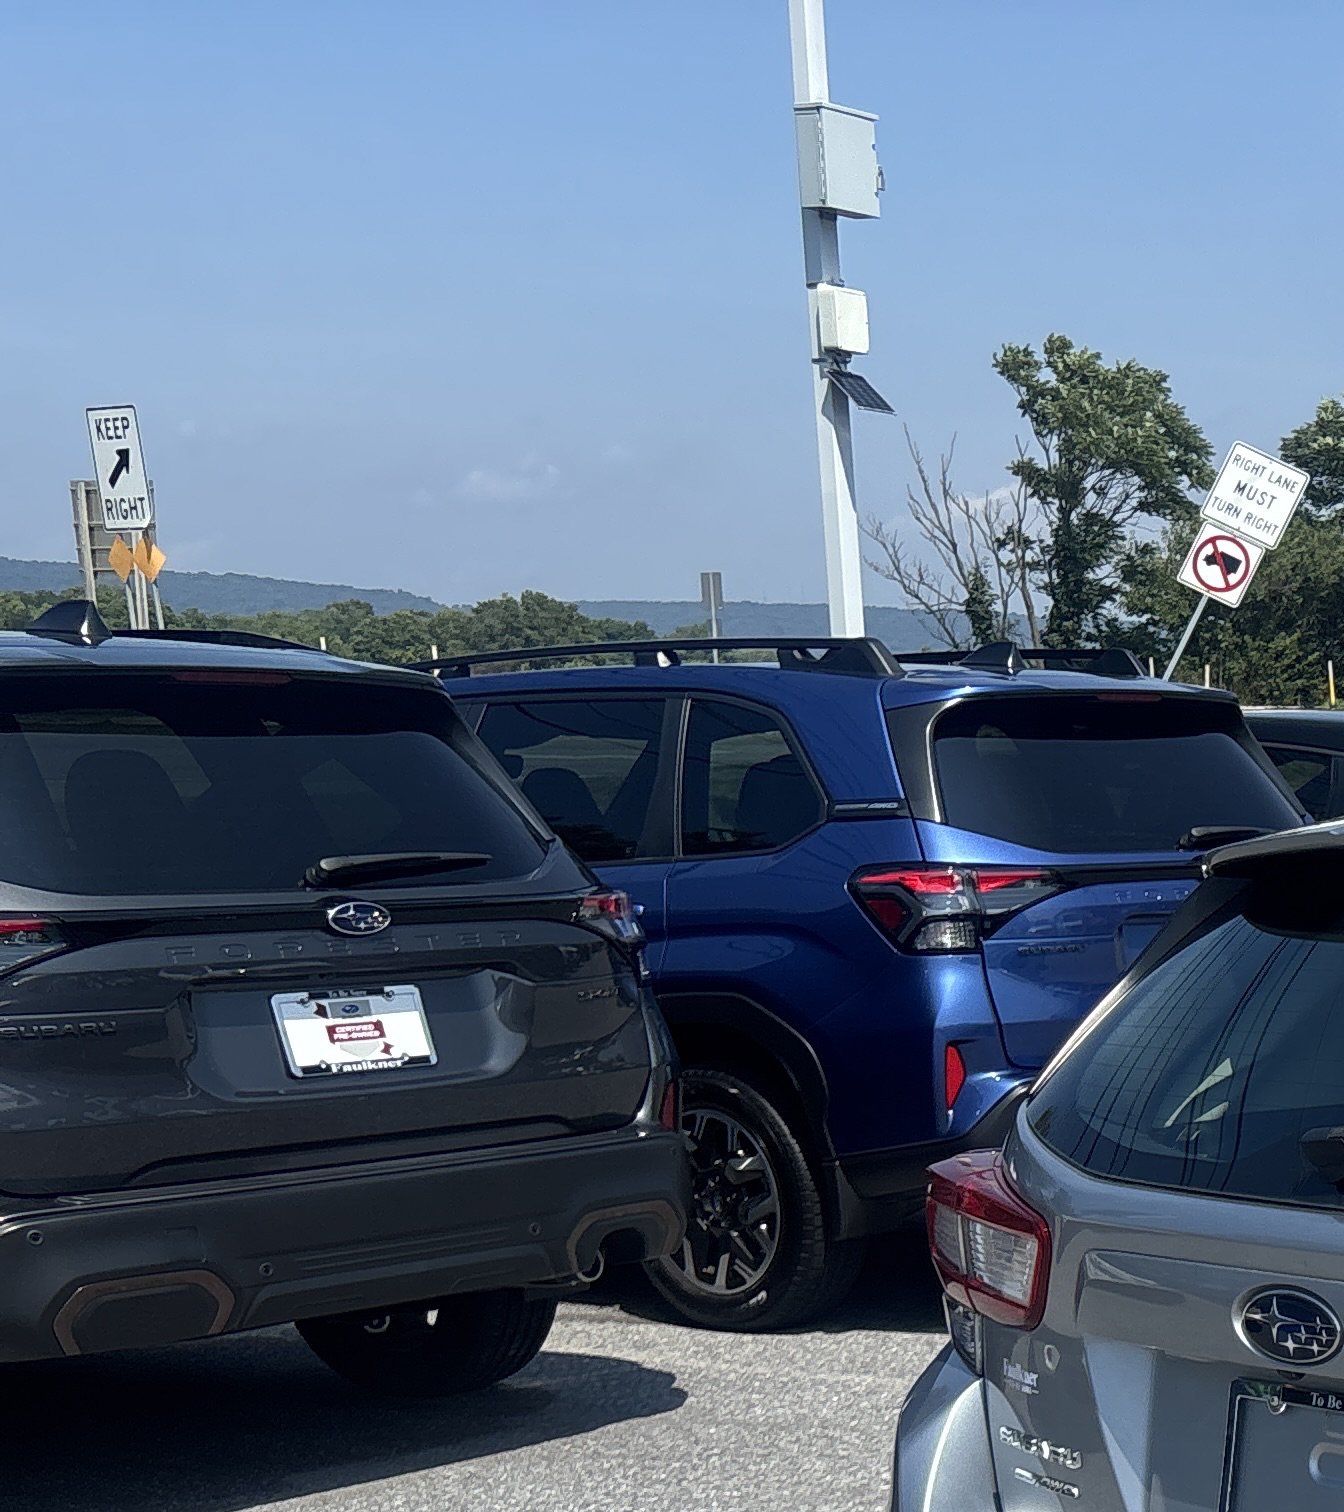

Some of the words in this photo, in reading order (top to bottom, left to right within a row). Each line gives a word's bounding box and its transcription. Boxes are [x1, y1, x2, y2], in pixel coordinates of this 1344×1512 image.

[95, 416, 130, 441] KEEP
[1232, 454, 1267, 478] RIGHT
[1267, 471, 1299, 494] LANE
[105, 497, 146, 520] RIGHT
[1233, 480, 1278, 510] MUST
[1211, 496, 1242, 519] TURN
[1243, 512, 1279, 536] RIGHT
[331, 1059, 404, 1073] Faulkner
[1310, 1392, 1325, 1407] To
[1328, 1395, 1343, 1410] Be
[1000, 1426, 1083, 1470] SUBARU
